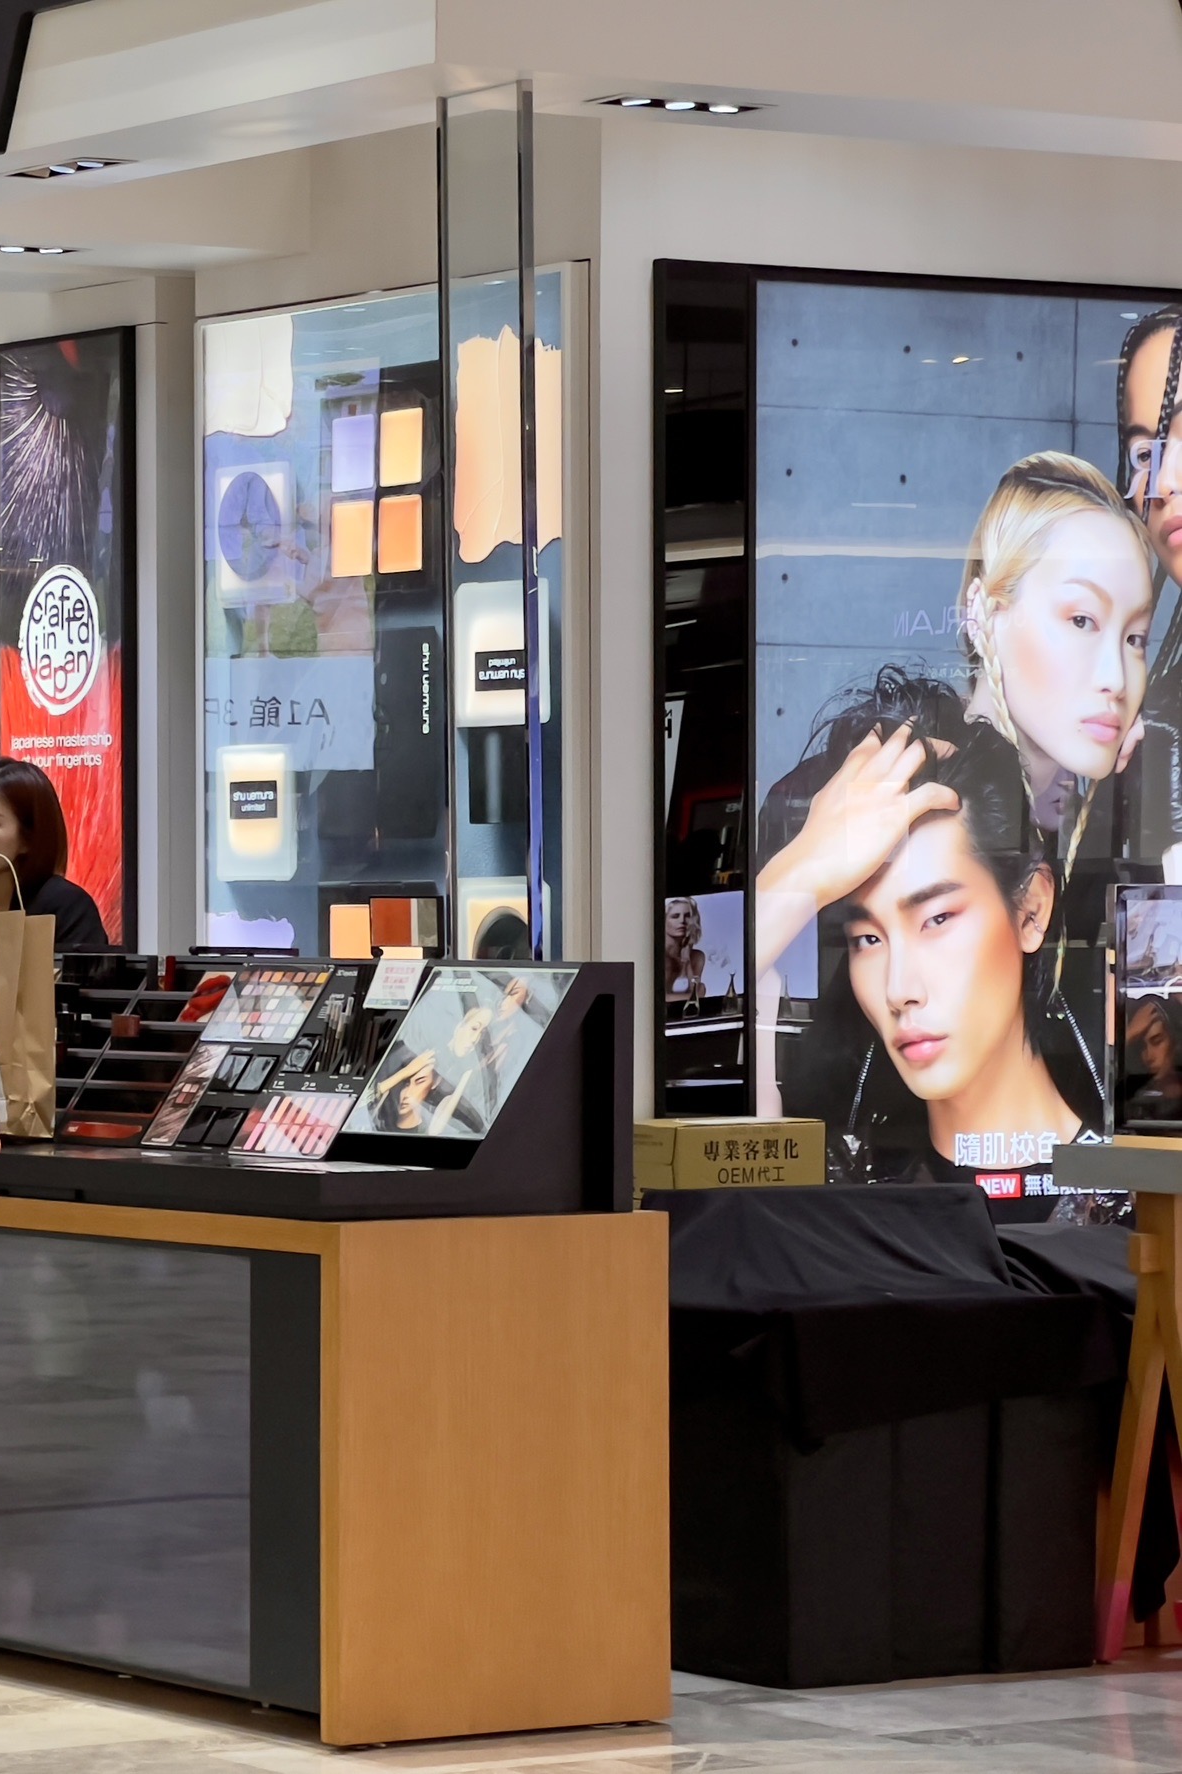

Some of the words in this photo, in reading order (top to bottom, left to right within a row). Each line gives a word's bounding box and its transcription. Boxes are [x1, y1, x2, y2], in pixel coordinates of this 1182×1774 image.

[42, 626, 57, 650] in
[33, 636, 89, 699] japan
[11, 734, 55, 752] japanese
[56, 731, 112, 748] mastership
[55, 752, 103, 770] fingertips
[979, 1178, 1017, 1195] NEW
